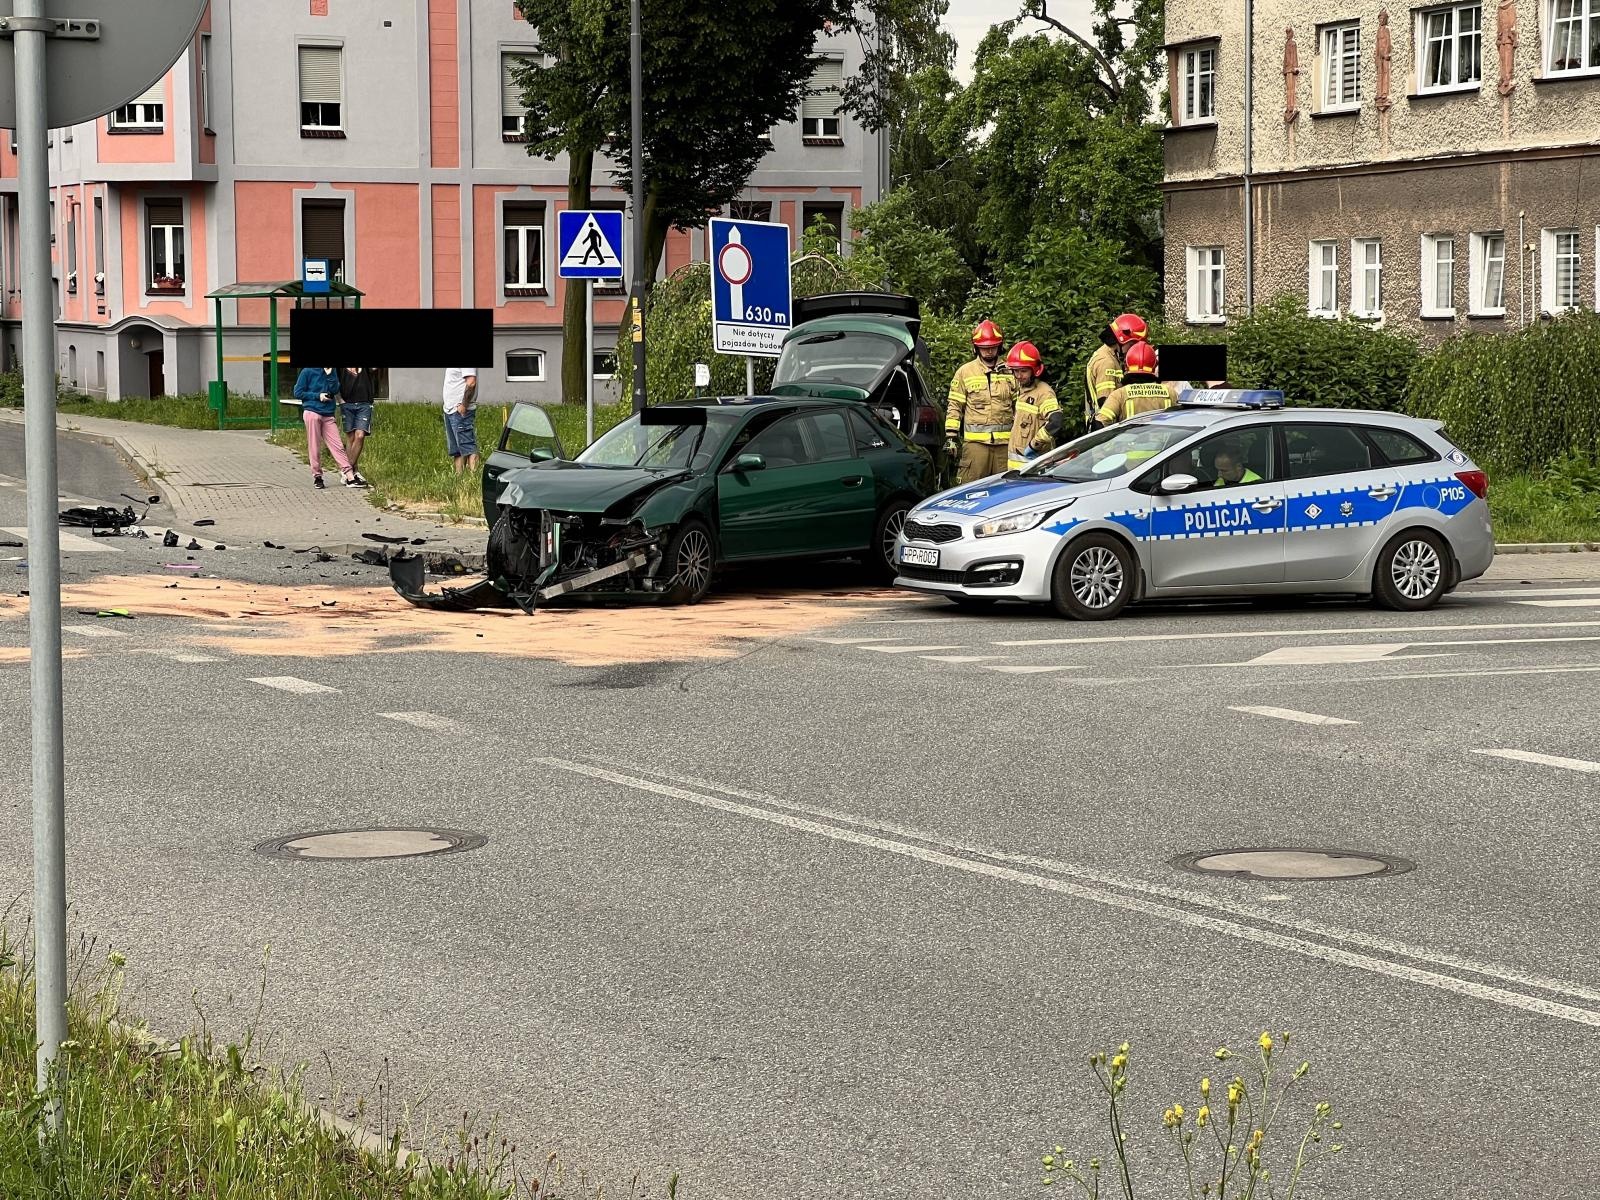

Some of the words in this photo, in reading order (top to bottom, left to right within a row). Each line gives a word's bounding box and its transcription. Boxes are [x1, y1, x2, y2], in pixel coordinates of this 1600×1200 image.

[745, 305, 772, 322] 630
[774, 312, 786, 324] m
[732, 328, 746, 337] Nie
[747, 329, 775, 341] dotyczy
[1195, 390, 1225, 402] POLICJA
[1441, 486, 1466, 502] P105
[1184, 507, 1252, 531] POLICJA
